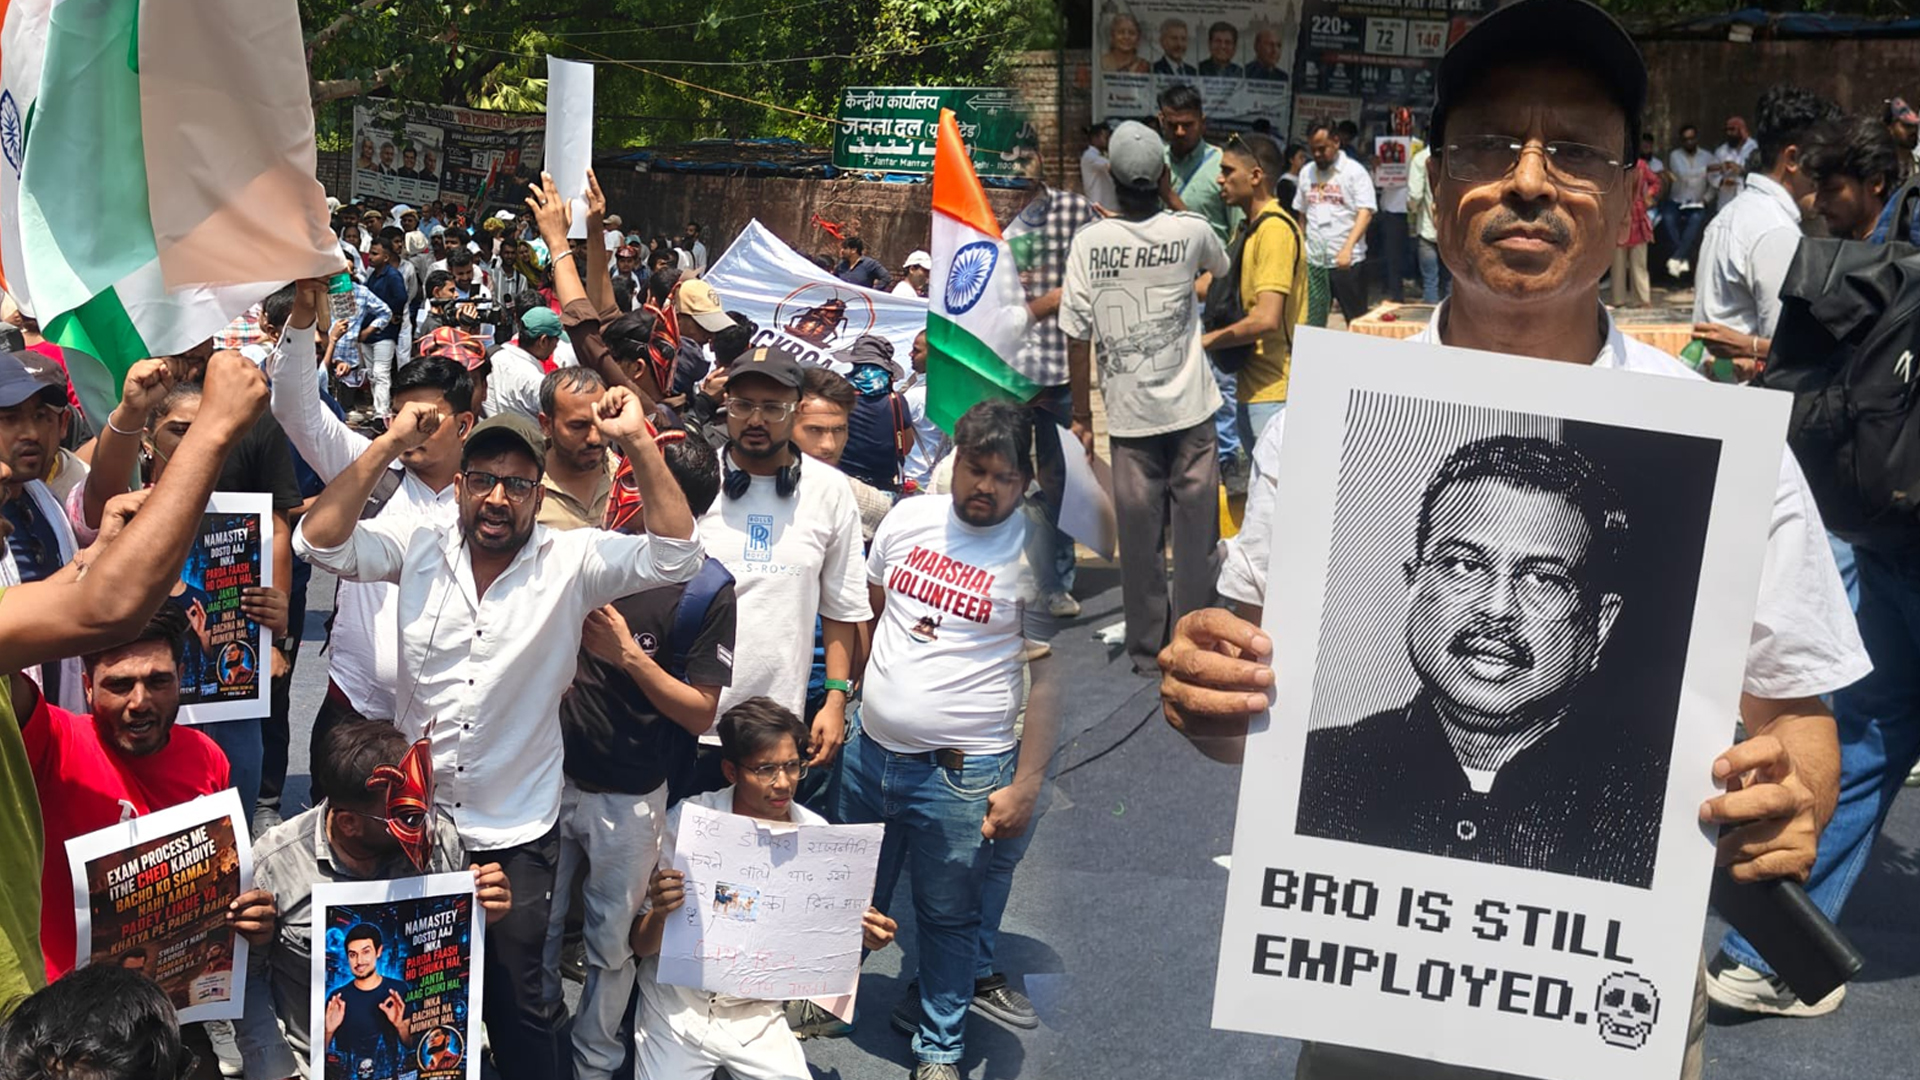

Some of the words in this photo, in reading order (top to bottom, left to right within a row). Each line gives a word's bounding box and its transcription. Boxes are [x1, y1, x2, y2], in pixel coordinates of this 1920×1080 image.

[1311, 15, 1351, 34] 220+
[1376, 29, 1394, 46] 72
[887, 91, 940, 110] कार्यालय
[873, 157, 898, 166] Jantar
[899, 158, 929, 167] Mantar
[1089, 246, 1132, 270] RACE
[1135, 238, 1190, 268] READY
[203, 527, 248, 548] NAMASTEY
[210, 545, 230, 558] DOSTO
[232, 543, 245, 555] AAJ
[206, 566, 227, 580] PARDA
[228, 562, 250, 576] FAASH
[220, 555, 235, 567] INKA
[905, 545, 996, 598] MARSHAL
[205, 580, 215, 591] HO
[216, 576, 237, 590] CHUKA
[218, 587, 238, 600] JANTA
[888, 565, 993, 625] VOLUNTEER
[212, 620, 236, 634] BACHNA
[236, 618, 245, 628] NA
[221, 610, 236, 622] INKA
[211, 631, 235, 646] MUMKIN
[106, 858, 140, 886] EXAM
[140, 834, 190, 870] PROCESS
[190, 825, 209, 846] ME
[109, 878, 136, 901] ITNE
[137, 862, 169, 889] CHED
[170, 839, 217, 874] KARDIYE
[115, 886, 153, 913] BACHO
[156, 878, 171, 896] KO
[172, 859, 211, 888] SAMAJ
[138, 896, 165, 917] NAHI
[168, 881, 197, 903] AARA
[121, 911, 161, 939] PADEY
[165, 893, 201, 919] LIKHE
[203, 886, 217, 901] YA
[405, 909, 458, 936] NAMASTEY
[1260, 866, 1380, 921] BRO
[1397, 887, 1453, 933] IS
[1472, 899, 1634, 964] STILL
[110, 930, 149, 955] KHATYA
[151, 922, 165, 937] PE
[167, 908, 201, 930] PADEY
[203, 893, 232, 915] RAHE
[412, 929, 437, 946] DOSTO
[438, 925, 453, 938] AAJ
[158, 939, 189, 958] SWAGAT
[406, 953, 431, 969] PARDA
[433, 944, 458, 960] FAASH
[423, 940, 441, 953] INKA
[405, 968, 417, 980] HO
[418, 960, 444, 977] CHUKA
[420, 971, 444, 987] JANTA
[1252, 933, 1588, 1025] EMPLOYED.
[405, 988, 423, 1002] JAAG
[424, 981, 446, 996] CHUKI
[412, 1006, 440, 1022] BACHNA
[441, 1002, 452, 1014] NA
[423, 995, 441, 1009] INKA
[410, 1016, 440, 1034] MUMKIN
